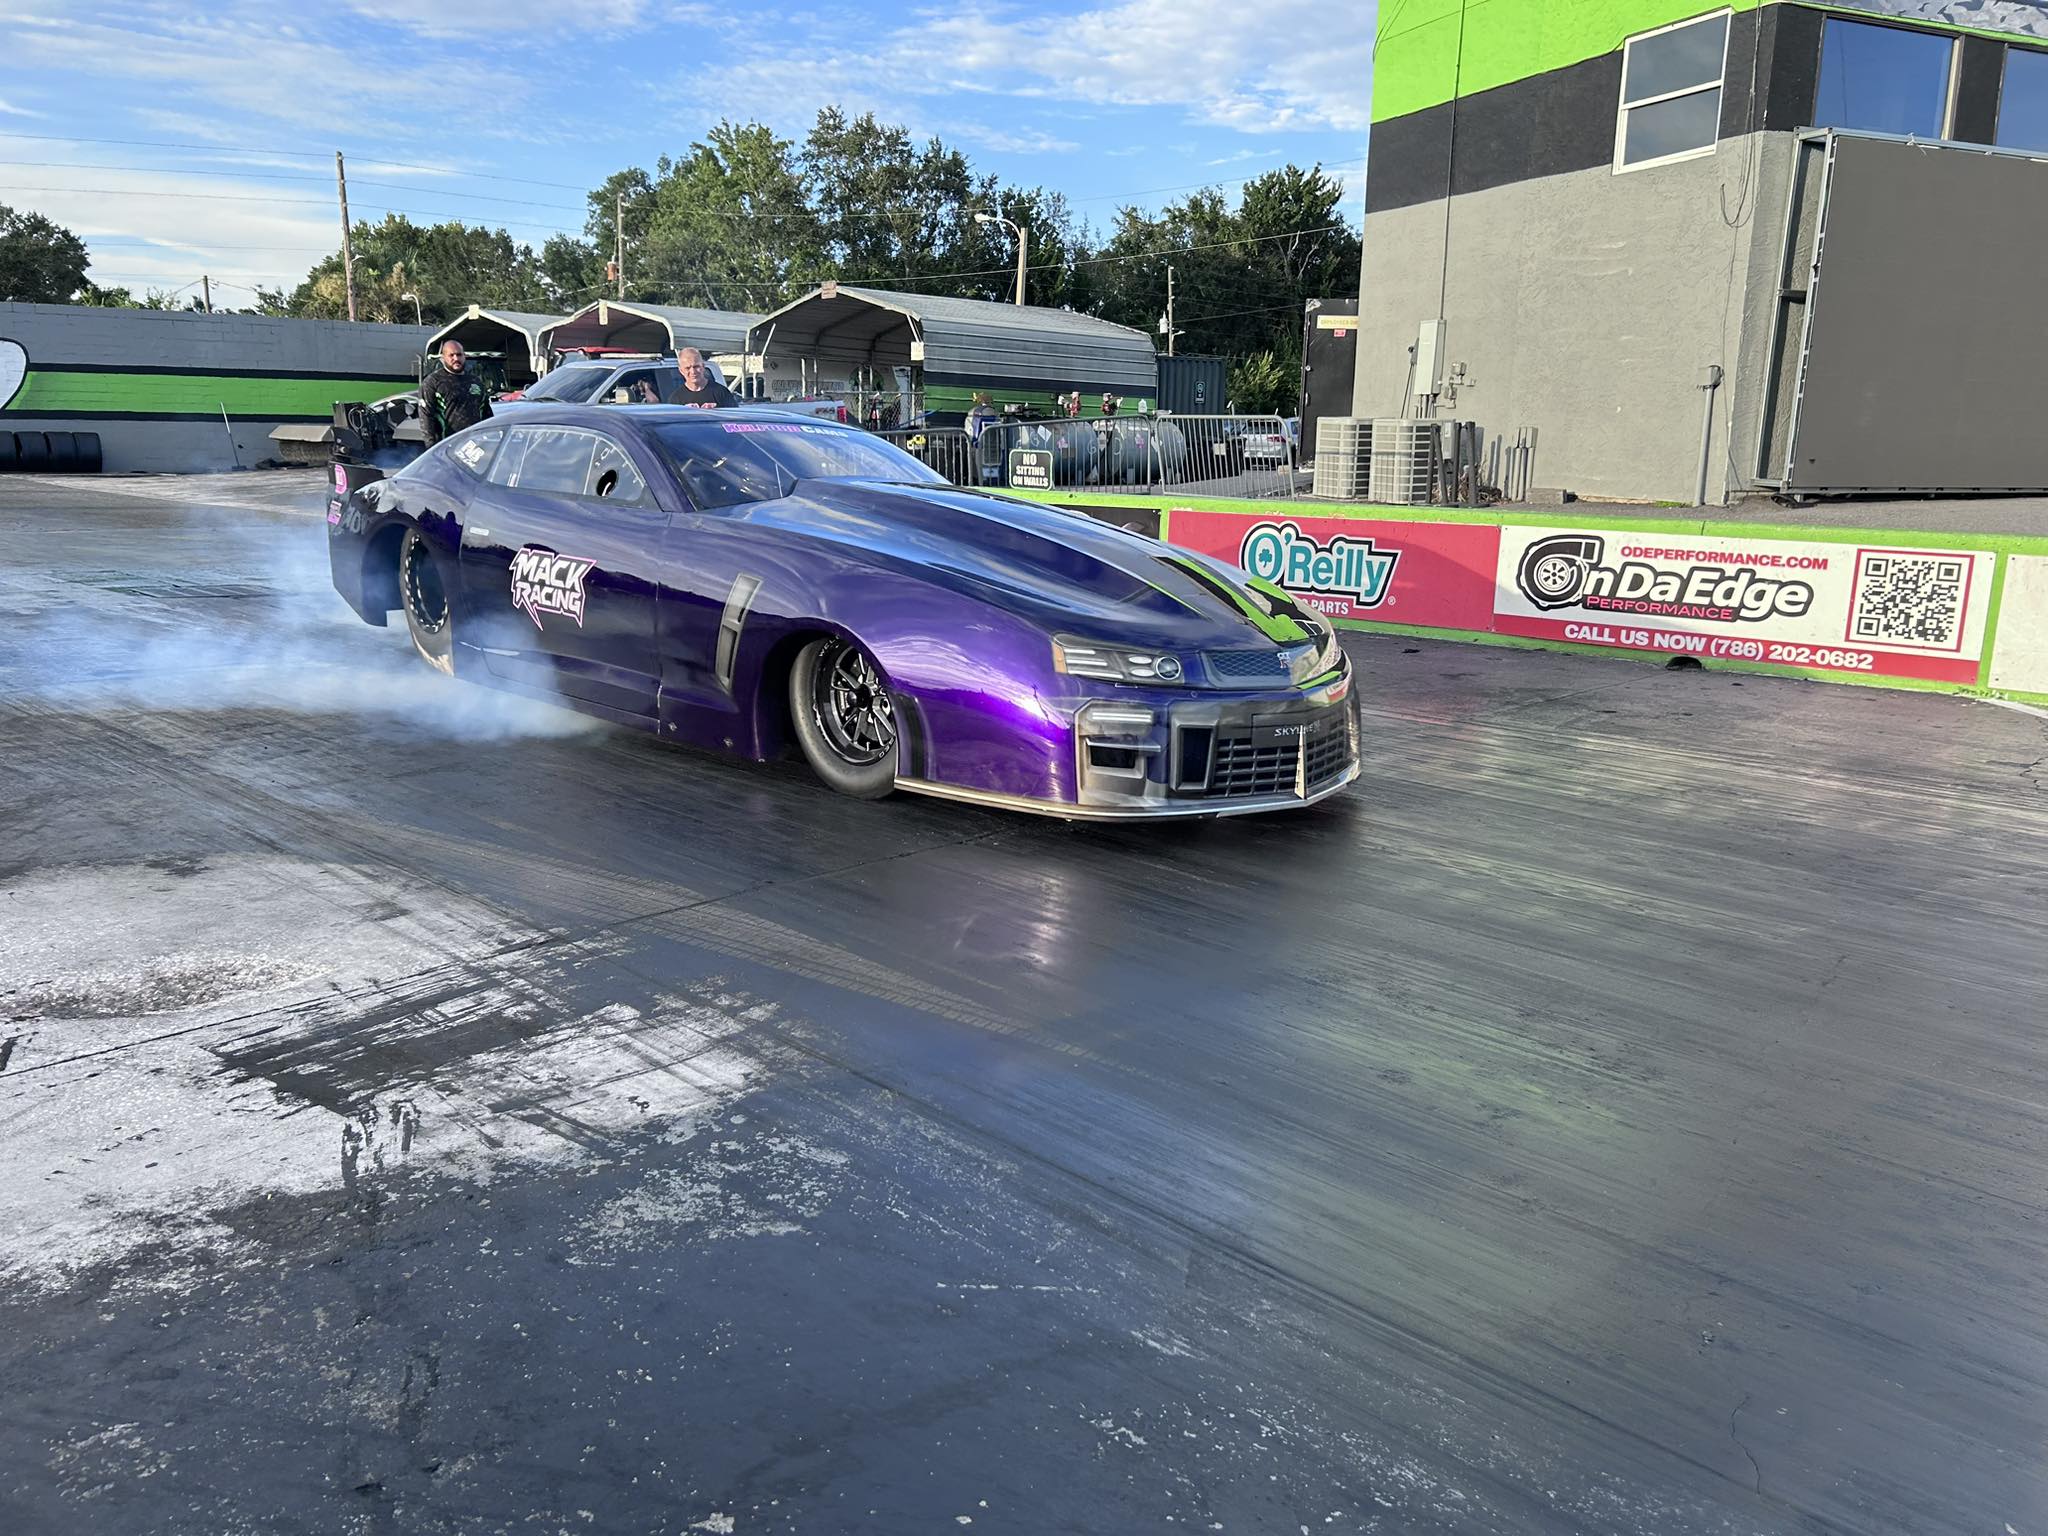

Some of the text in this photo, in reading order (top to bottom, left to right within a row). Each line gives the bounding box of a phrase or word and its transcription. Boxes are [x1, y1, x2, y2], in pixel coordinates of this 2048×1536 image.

[1016, 465, 1045, 476] SITTING
[1023, 453, 1037, 465] NO
[1013, 475, 1049, 487] ON WALLS
[1247, 531, 1387, 598] O'Reilly
[1620, 545, 1829, 570] ODEPERFORMANCE.COM
[515, 553, 588, 592] MACK
[515, 581, 581, 616] RACING
[1311, 599, 1349, 615] PARTS
[1586, 596, 1733, 620] PERFORMANCE
[1564, 624, 1874, 670] CALL US NOW (786) 202-0682
